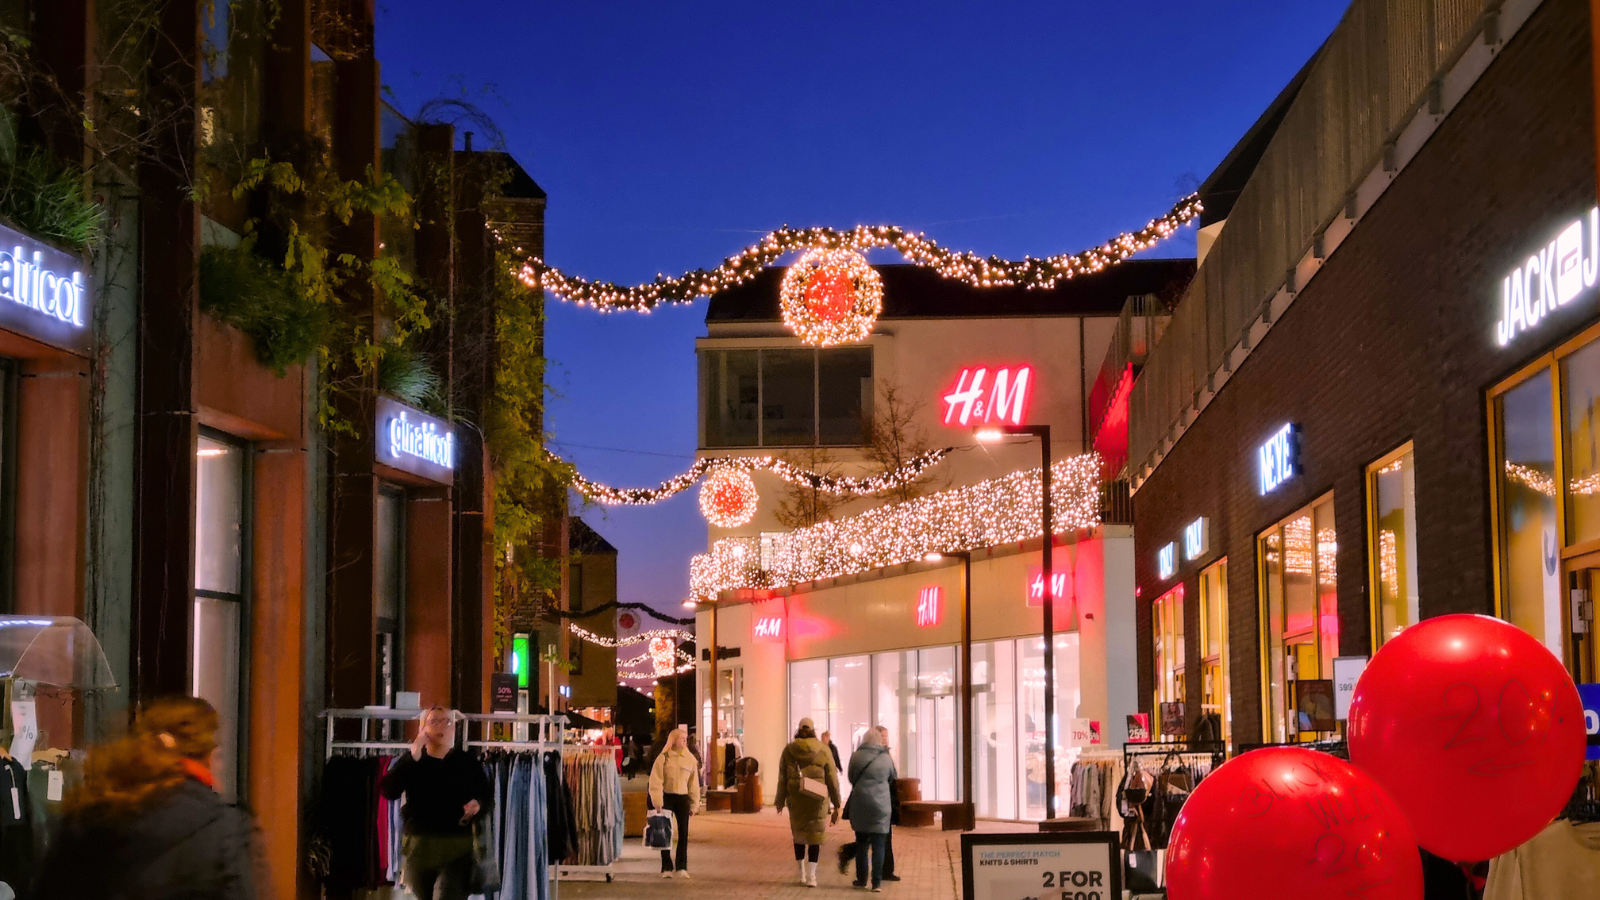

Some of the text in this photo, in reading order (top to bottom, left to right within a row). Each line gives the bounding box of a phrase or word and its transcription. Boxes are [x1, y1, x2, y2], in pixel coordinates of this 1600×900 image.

[1498, 240, 1556, 346] JACK
[944, 367, 1029, 426] H&M
[1259, 422, 1293, 496] NEYE
[754, 617, 781, 637] H&M
[1073, 731, 1088, 740] 70%
[1128, 728, 1148, 740] 25%
[1010, 858, 1039, 866] SHIRTS
[1033, 850, 1061, 858] MATCH
[1042, 870, 1103, 887] 2 FOR
